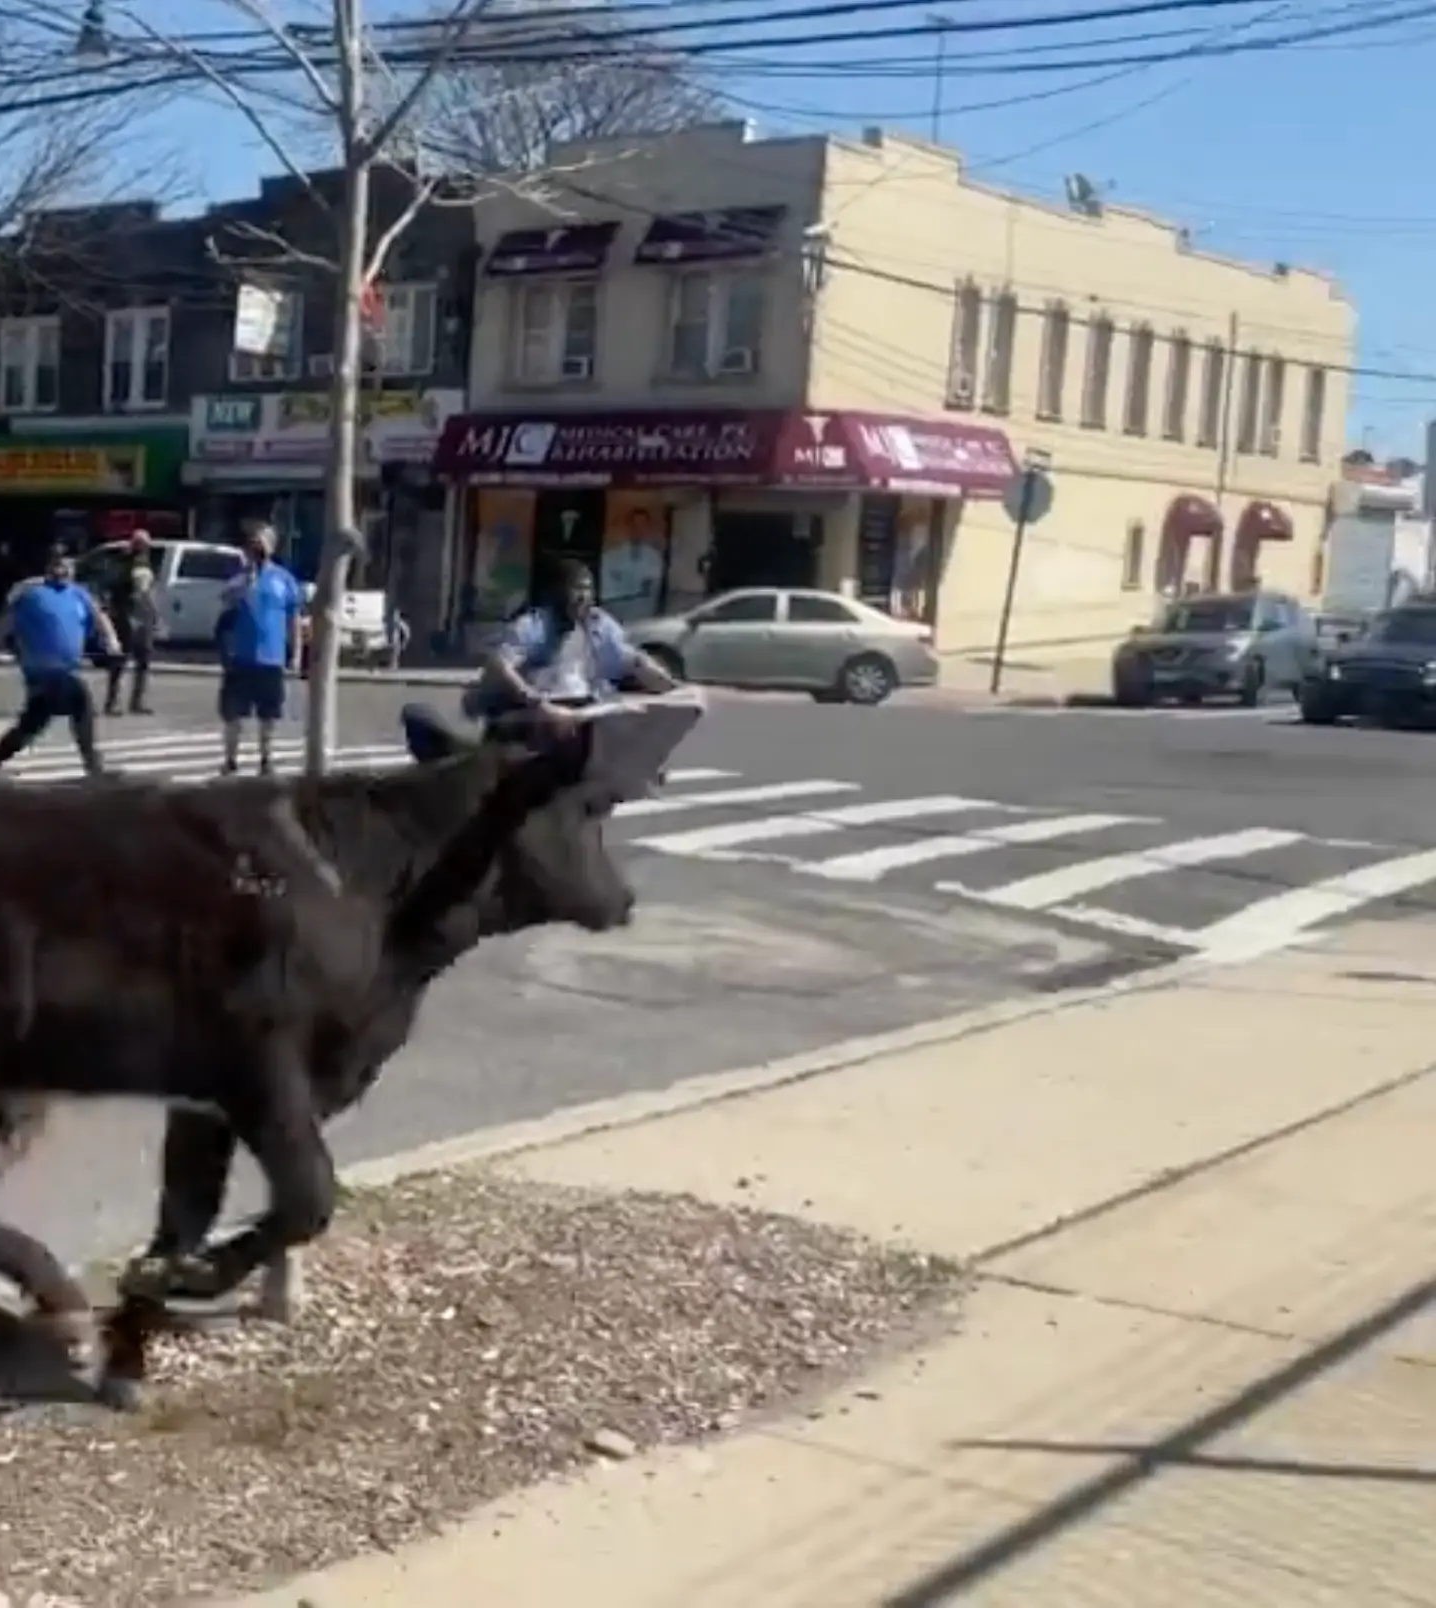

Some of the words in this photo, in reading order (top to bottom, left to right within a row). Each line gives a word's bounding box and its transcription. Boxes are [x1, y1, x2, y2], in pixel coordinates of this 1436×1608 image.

[212, 401, 257, 424] NEW
[560, 423, 643, 440] MEDICAL
[457, 422, 555, 464] MJC
[550, 441, 753, 462] REHABILITATION
